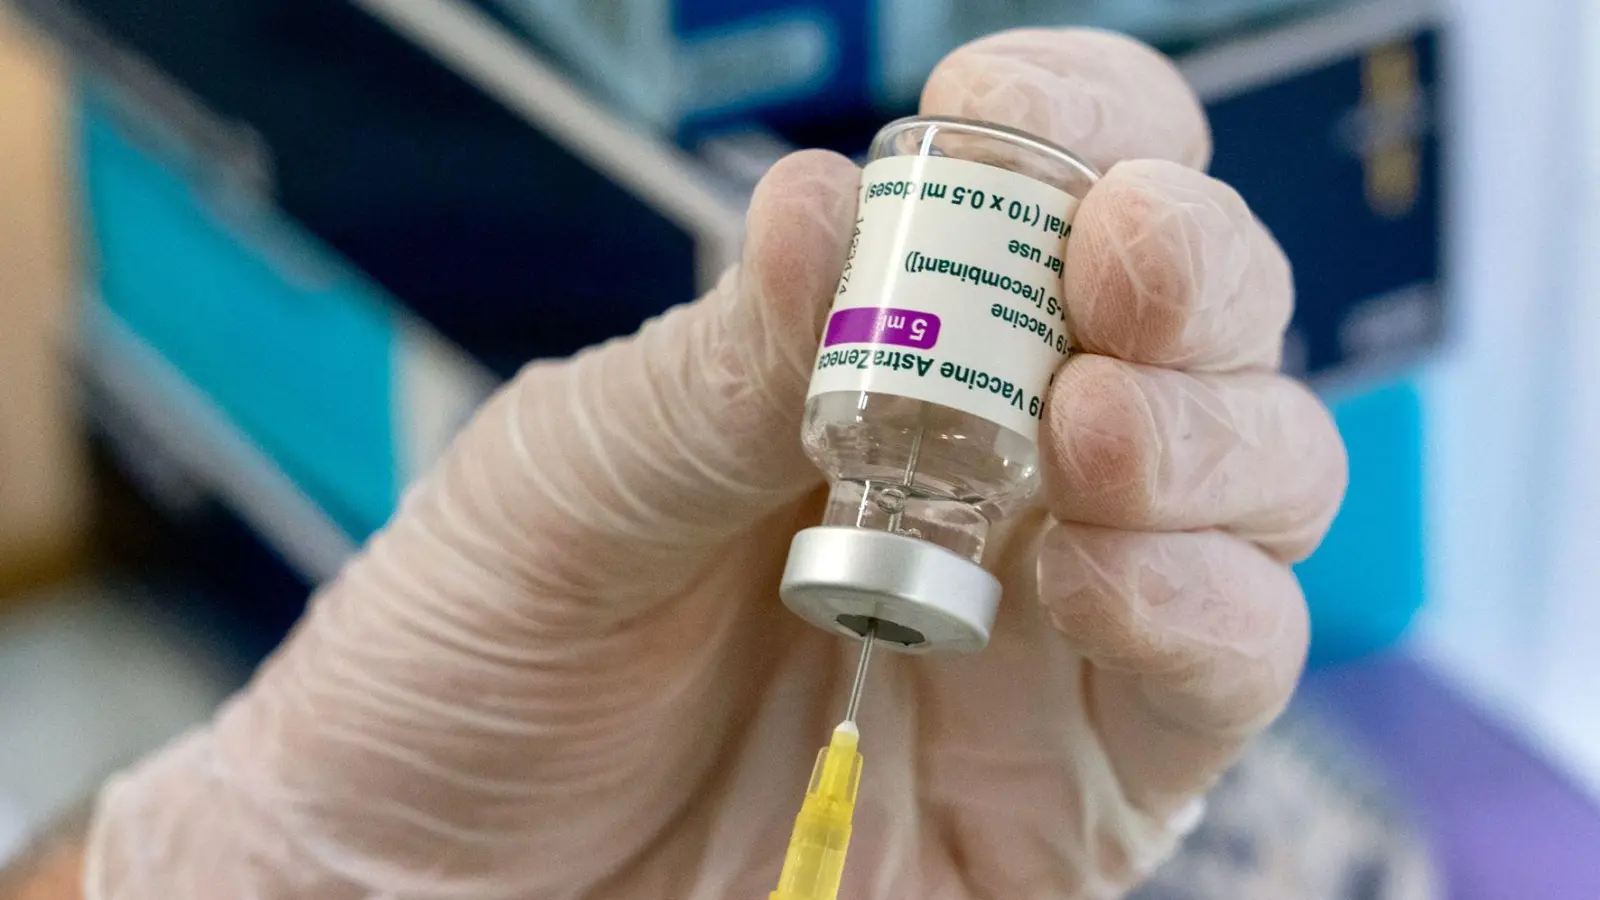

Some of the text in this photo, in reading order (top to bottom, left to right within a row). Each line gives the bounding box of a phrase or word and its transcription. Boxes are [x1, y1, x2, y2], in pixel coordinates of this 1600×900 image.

[864, 181, 1072, 239] vial (10 x 0.5 ml doses)
[1008, 240, 1042, 263] use
[905, 251, 1045, 309] [recombinant])
[881, 315, 928, 341] 5 ml
[991, 303, 1053, 347] Vaccine
[818, 349, 935, 377] AstraZeneca
[940, 362, 1023, 410] Vaccine
